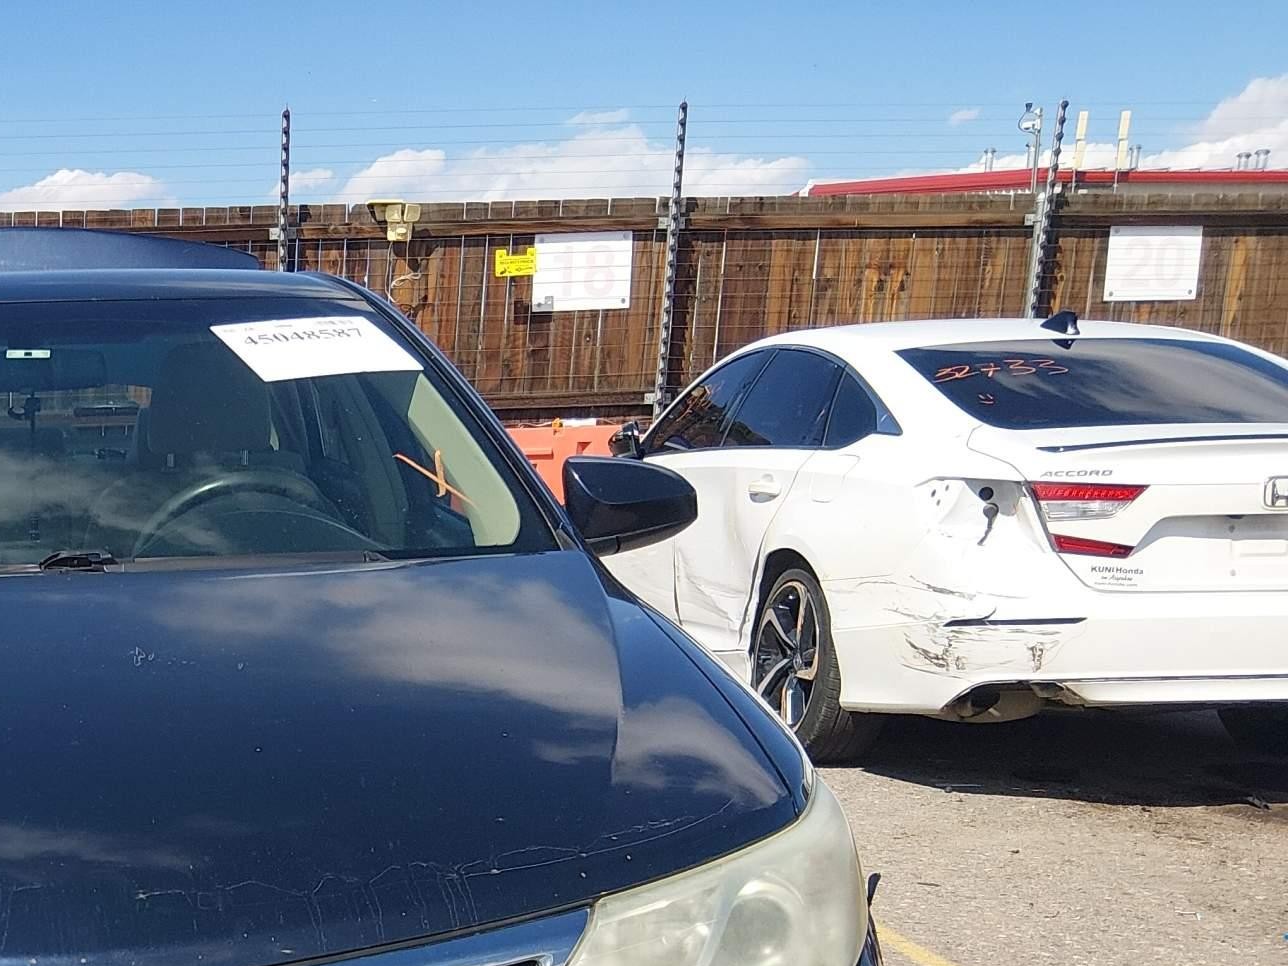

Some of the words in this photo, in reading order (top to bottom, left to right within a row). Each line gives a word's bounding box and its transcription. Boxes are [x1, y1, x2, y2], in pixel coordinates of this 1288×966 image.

[553, 245, 615, 297] 18
[244, 328, 362, 345] 45048587
[1040, 470, 1113, 478] ACCORD
